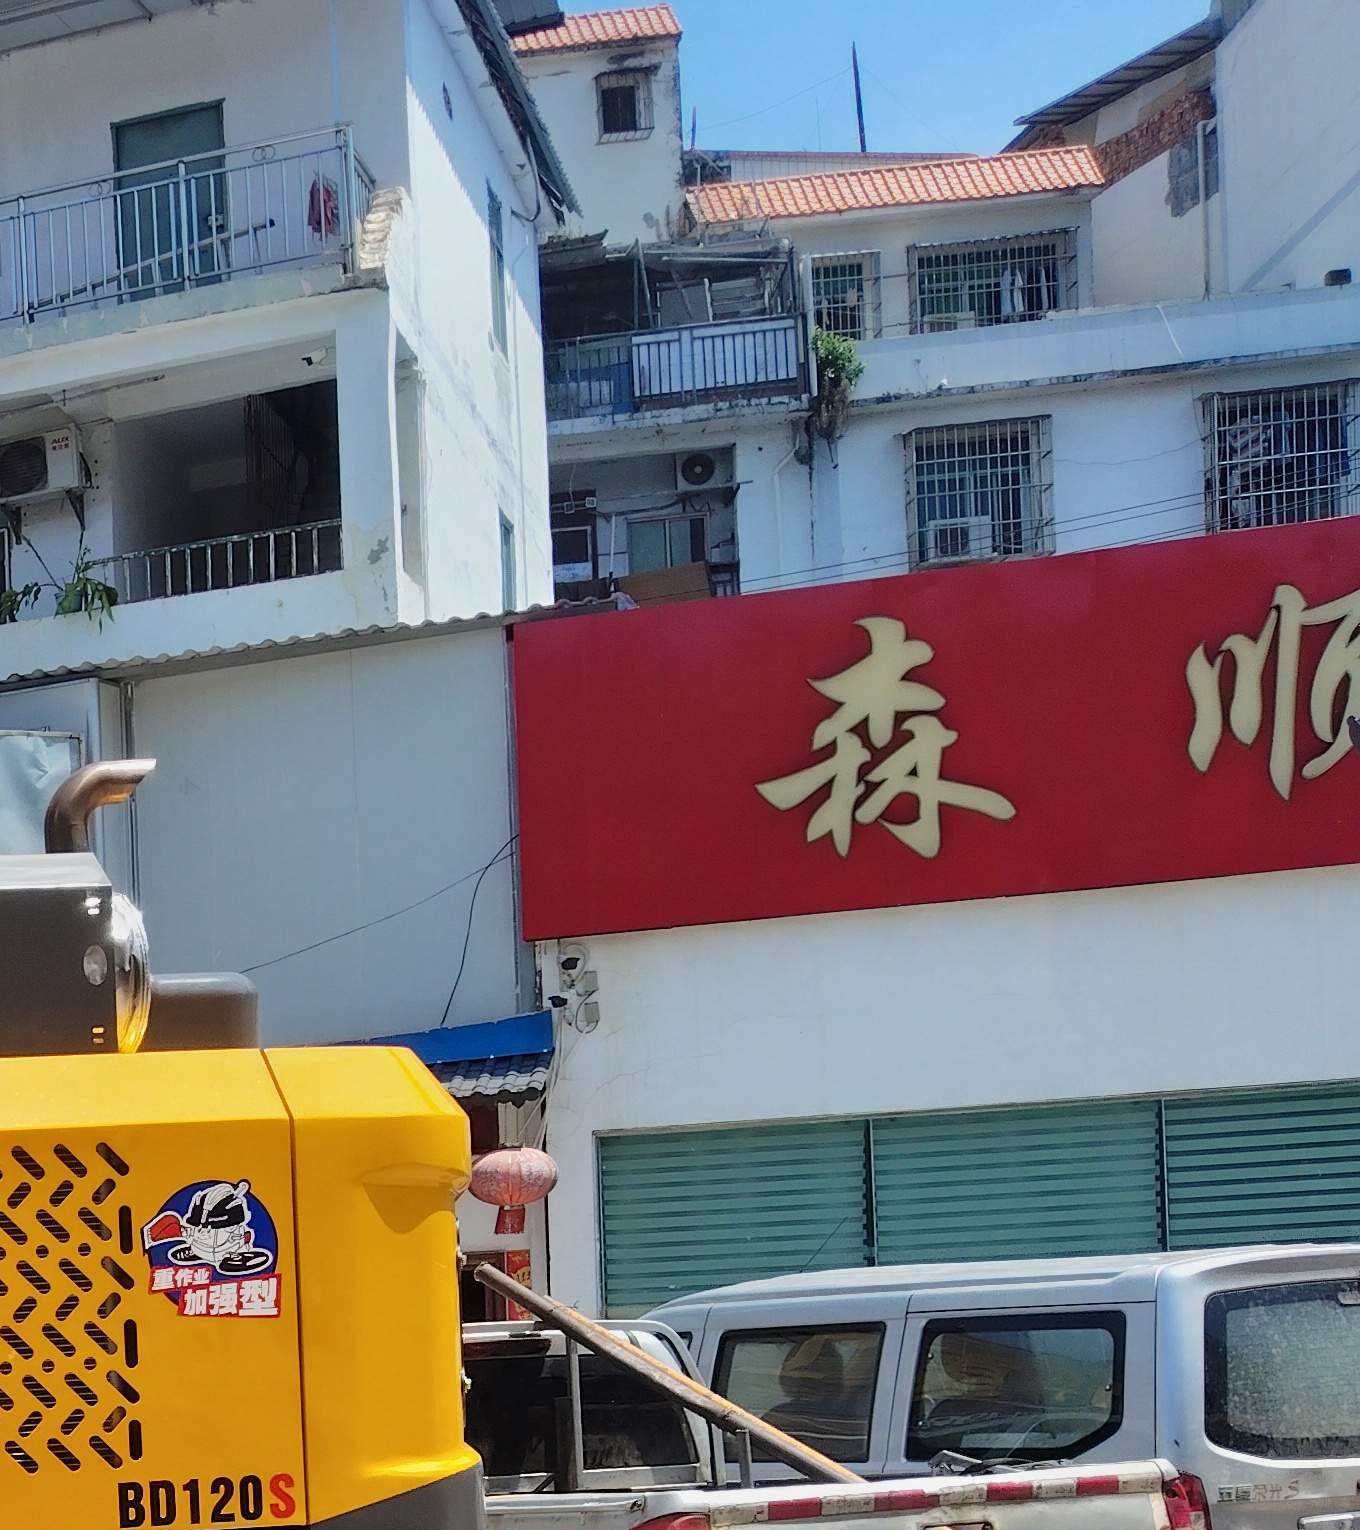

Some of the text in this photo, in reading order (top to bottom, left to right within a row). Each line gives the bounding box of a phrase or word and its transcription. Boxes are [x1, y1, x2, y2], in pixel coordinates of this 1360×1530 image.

[152, 1267, 211, 1291] 重作业
[183, 1277, 278, 1317] 加强型
[118, 1473, 296, 1528] BD120S
